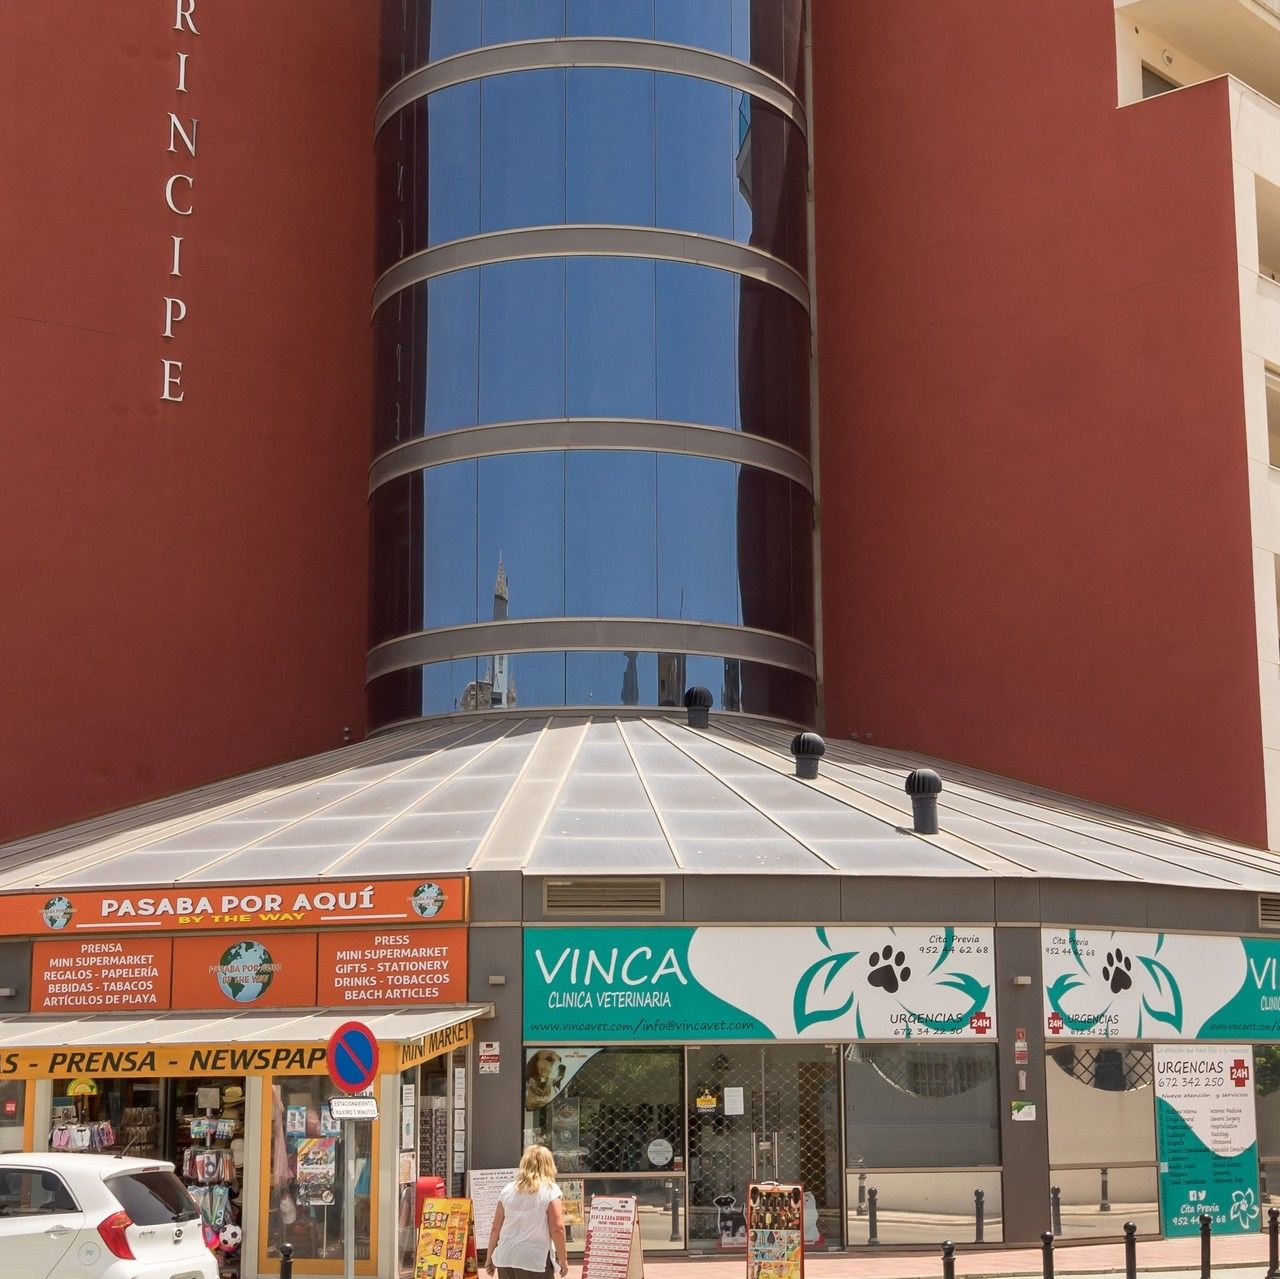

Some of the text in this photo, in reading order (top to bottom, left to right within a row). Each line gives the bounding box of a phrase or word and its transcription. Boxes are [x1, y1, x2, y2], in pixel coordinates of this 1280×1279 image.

[100, 896, 214, 918] PASABA
[221, 894, 283, 913] POR
[292, 885, 375, 911] AQUÍ
[178, 912, 306, 924] BY THE WAY
[374, 935, 410, 946] PRESS
[928, 934, 980, 944] Cita Previa
[1052, 936, 1089, 946] Cita Previa
[81, 943, 123, 954] PRENSA
[336, 946, 449, 961] MINI SUPERMARKET
[919, 946, 989, 954] 952 44 62 68
[1074, 948, 1084, 956] 62
[49, 954, 154, 968] MINI SUPERMARKET
[335, 960, 450, 974] GIFTS STATIONERY
[535, 946, 688, 986] VINCA
[43, 966, 159, 981] REGALOS PAPELERÍA
[334, 973, 450, 988] DRINKS TOBACCOS
[48, 980, 153, 994] BEBIDAS TABACOS
[344, 987, 439, 1000] BEACH ARTICLES
[548, 990, 671, 1009] CLINICA VETERINARIA
[43, 993, 157, 1007] ARTÍCULOS DE PLAYA
[890, 1012, 963, 1025] URGENCIAS
[971, 1018, 990, 1028] 24H
[1049, 1020, 1063, 1028] 24H
[1067, 1013, 1119, 1024] URGENCIAS
[894, 1028, 963, 1036] 672 34 22 50
[1098, 1028, 1108, 1036] 22
[1110, 1028, 1119, 1036] 50
[401, 1021, 470, 1065] MINI MARKET
[48, 1050, 157, 1074] PRENSA
[189, 1048, 329, 1071] NEWSPAP
[1157, 1061, 1224, 1074] URGENCIAS
[1232, 1068, 1248, 1078] 24H
[1158, 1077, 1224, 1088] 672 342 250
[1180, 1202, 1220, 1214] Cita Previa
[1172, 1217, 1188, 1226] 952
[1190, 1216, 1200, 1225] 44
